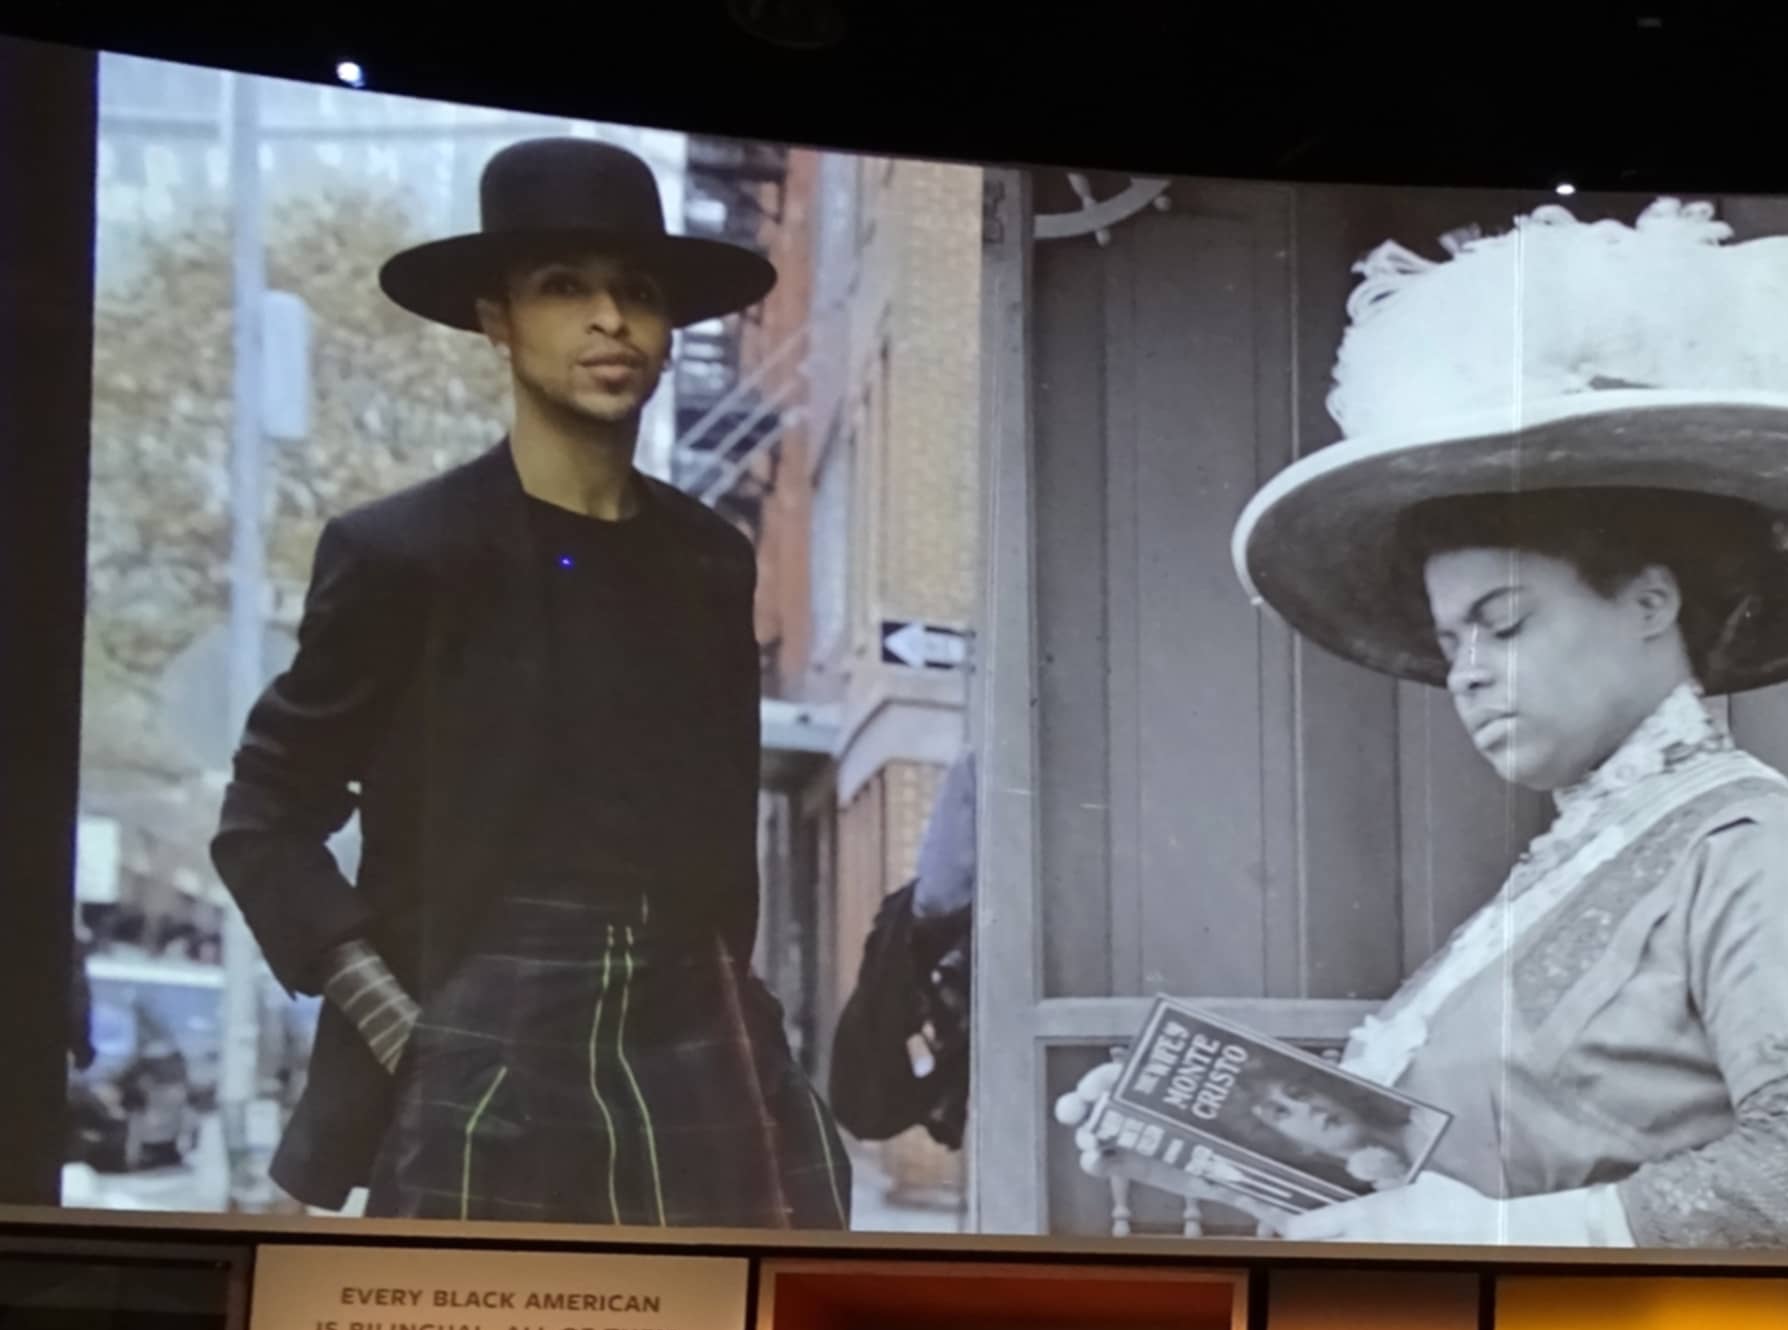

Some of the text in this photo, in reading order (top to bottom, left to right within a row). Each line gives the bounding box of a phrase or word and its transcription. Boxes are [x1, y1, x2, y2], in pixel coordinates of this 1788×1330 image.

[1162, 1034, 1221, 1110] MONTE
[1191, 1044, 1249, 1120] CRISTO
[341, 1287, 659, 1311] EVERY BLACK AMERICAN
